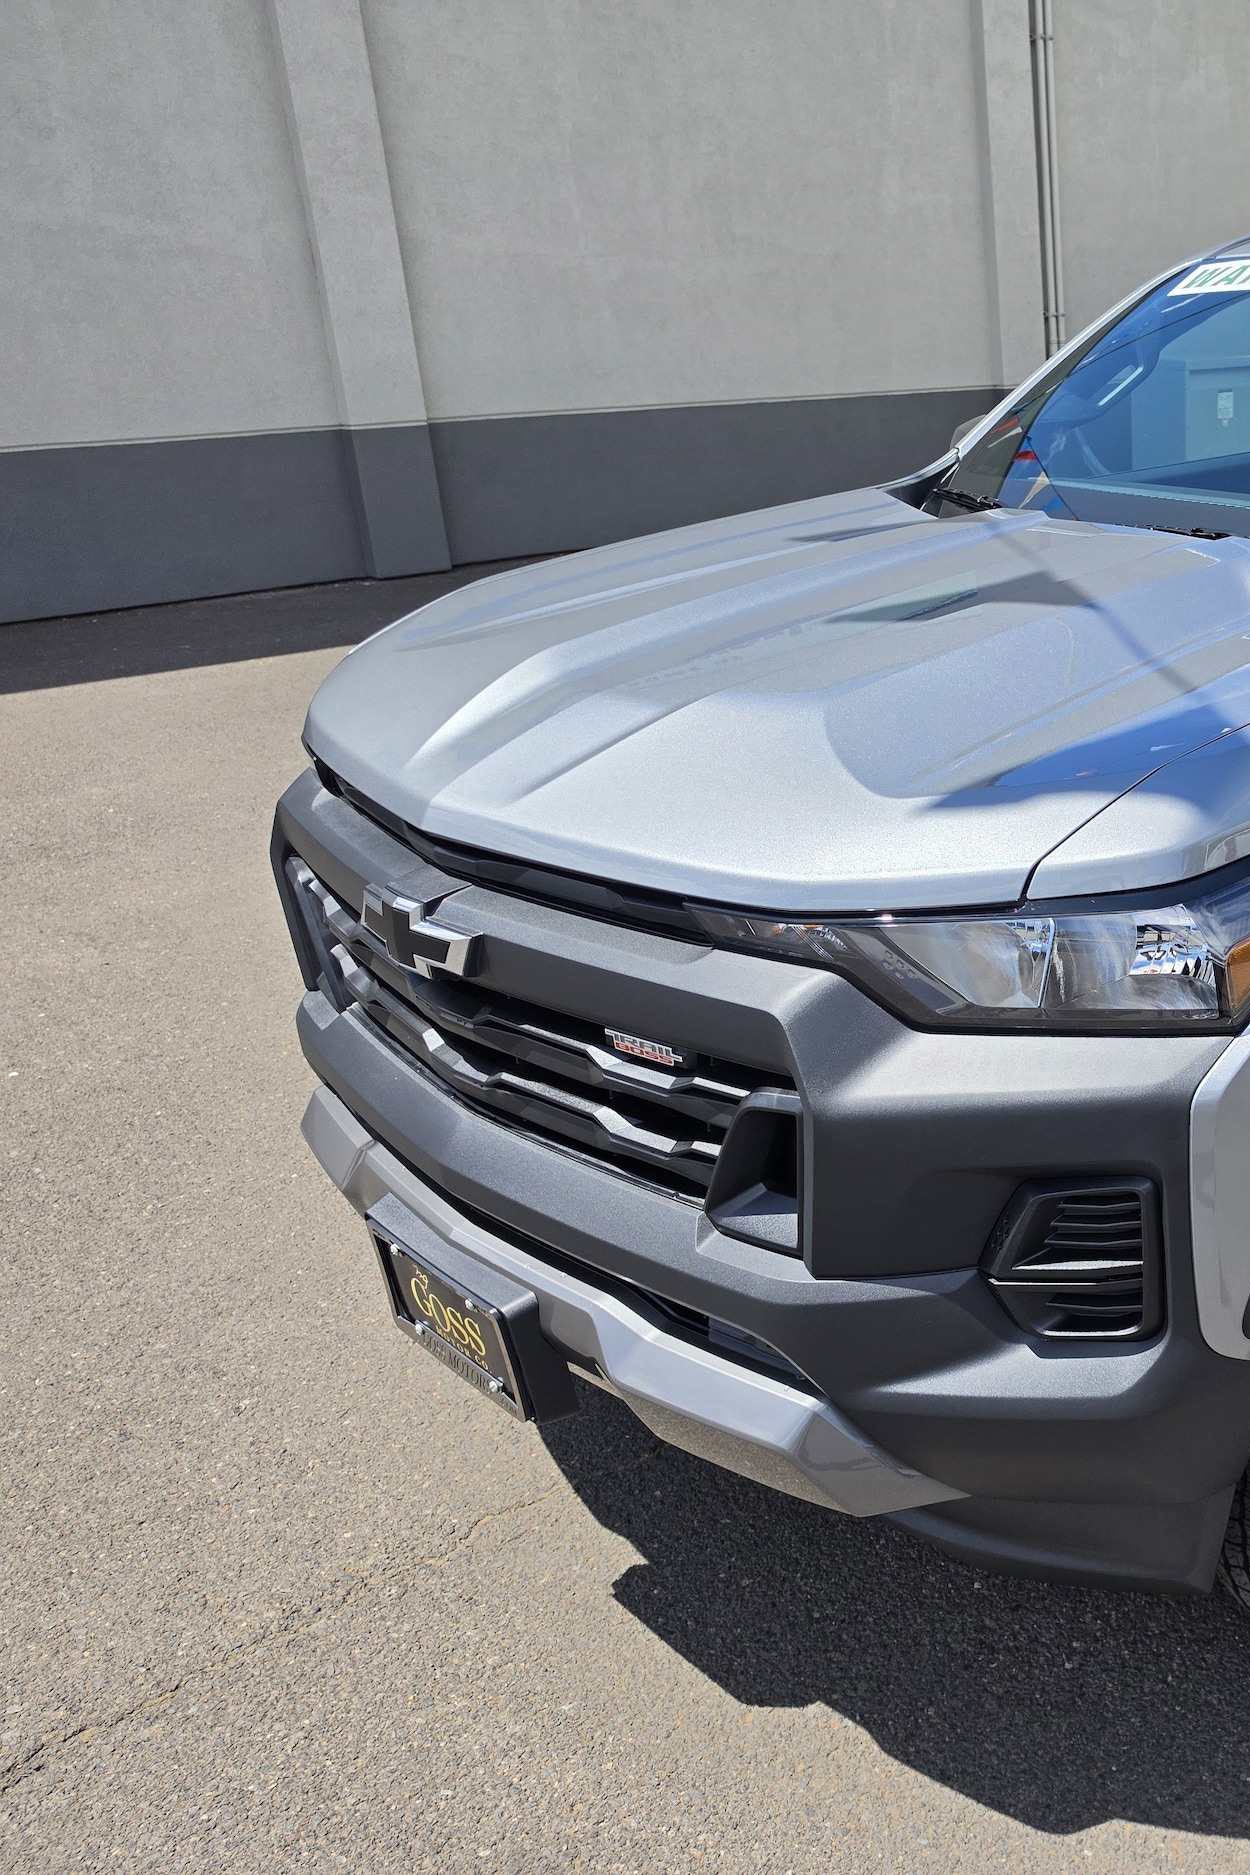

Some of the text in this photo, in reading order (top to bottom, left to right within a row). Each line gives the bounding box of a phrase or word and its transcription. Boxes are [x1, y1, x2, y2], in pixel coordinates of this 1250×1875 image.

[604, 1028, 683, 1063] TRAIL
[614, 1040, 675, 1067] BOSS
[411, 1277, 486, 1357] GOSS
[435, 1326, 472, 1359] MOTOR
